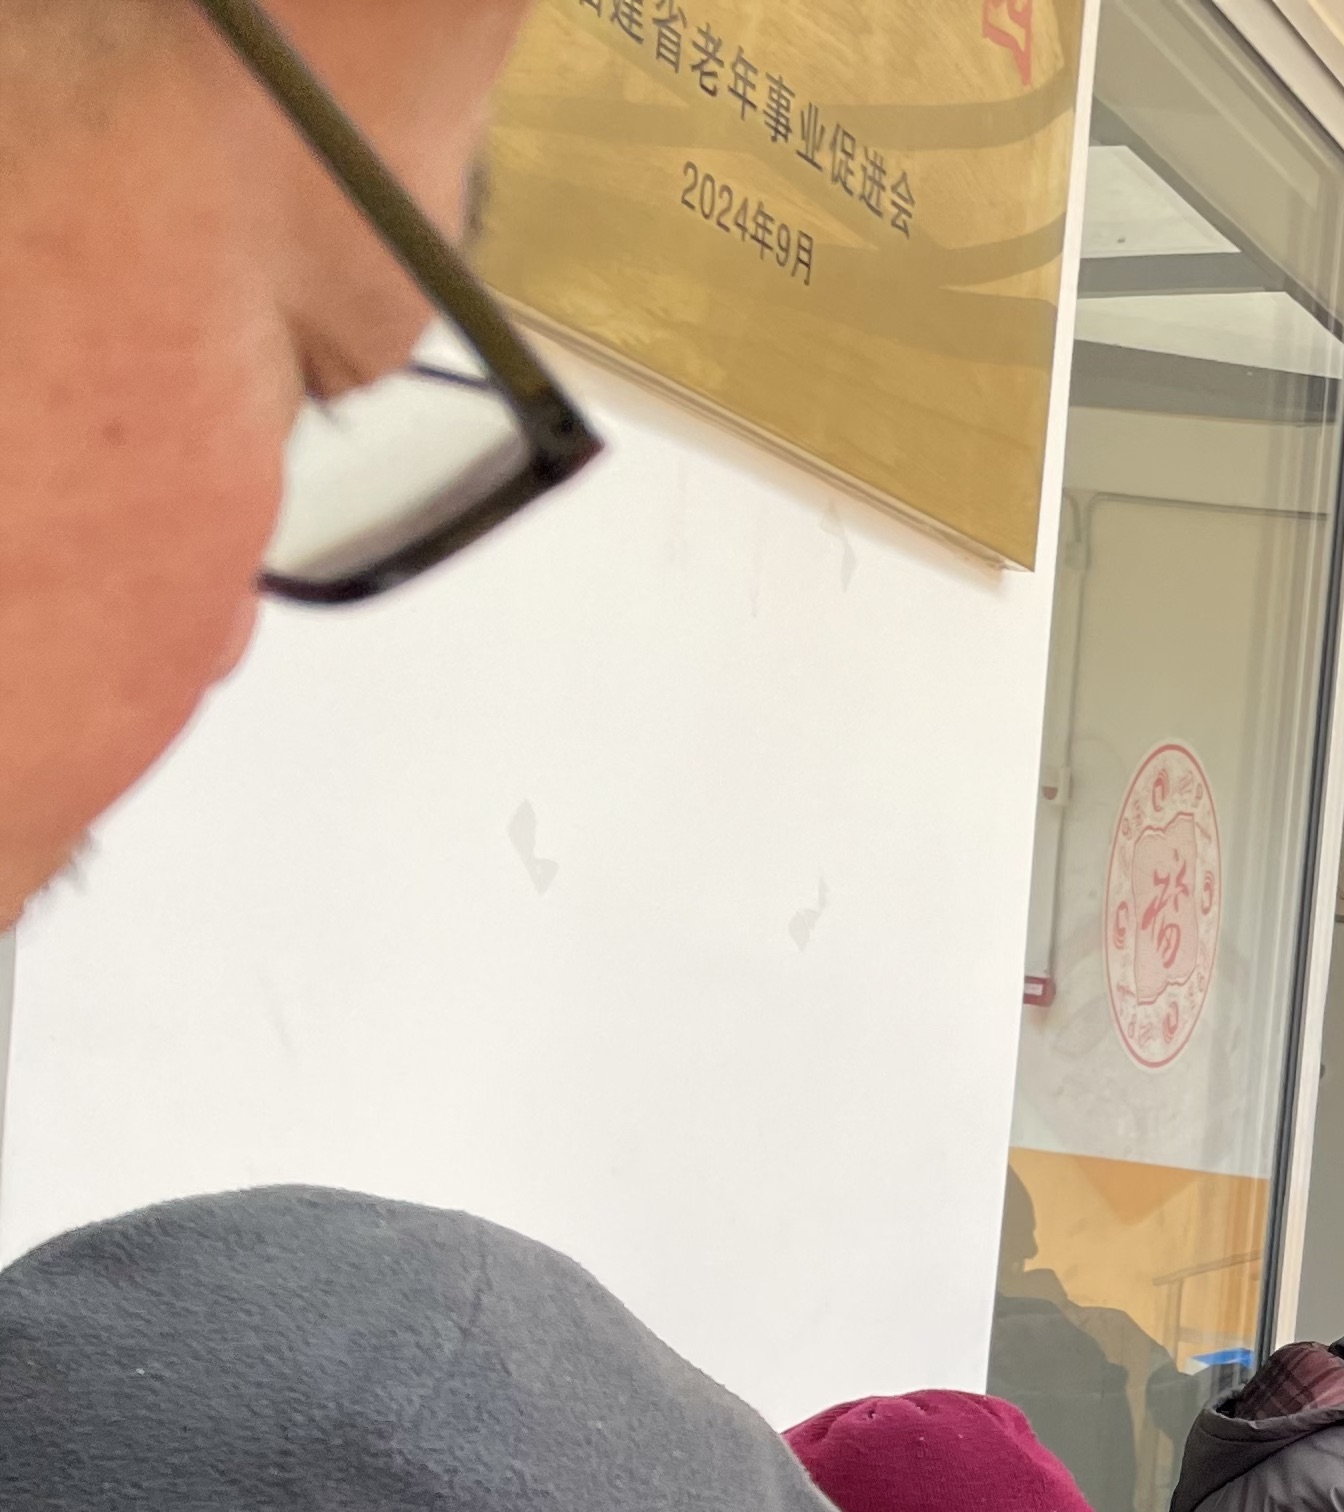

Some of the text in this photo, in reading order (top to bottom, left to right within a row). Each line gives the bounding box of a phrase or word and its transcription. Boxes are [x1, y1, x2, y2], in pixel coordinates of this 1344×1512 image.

[579, 0, 916, 240] 建省老年事业促进会
[681, 160, 814, 286] 2024年9月
